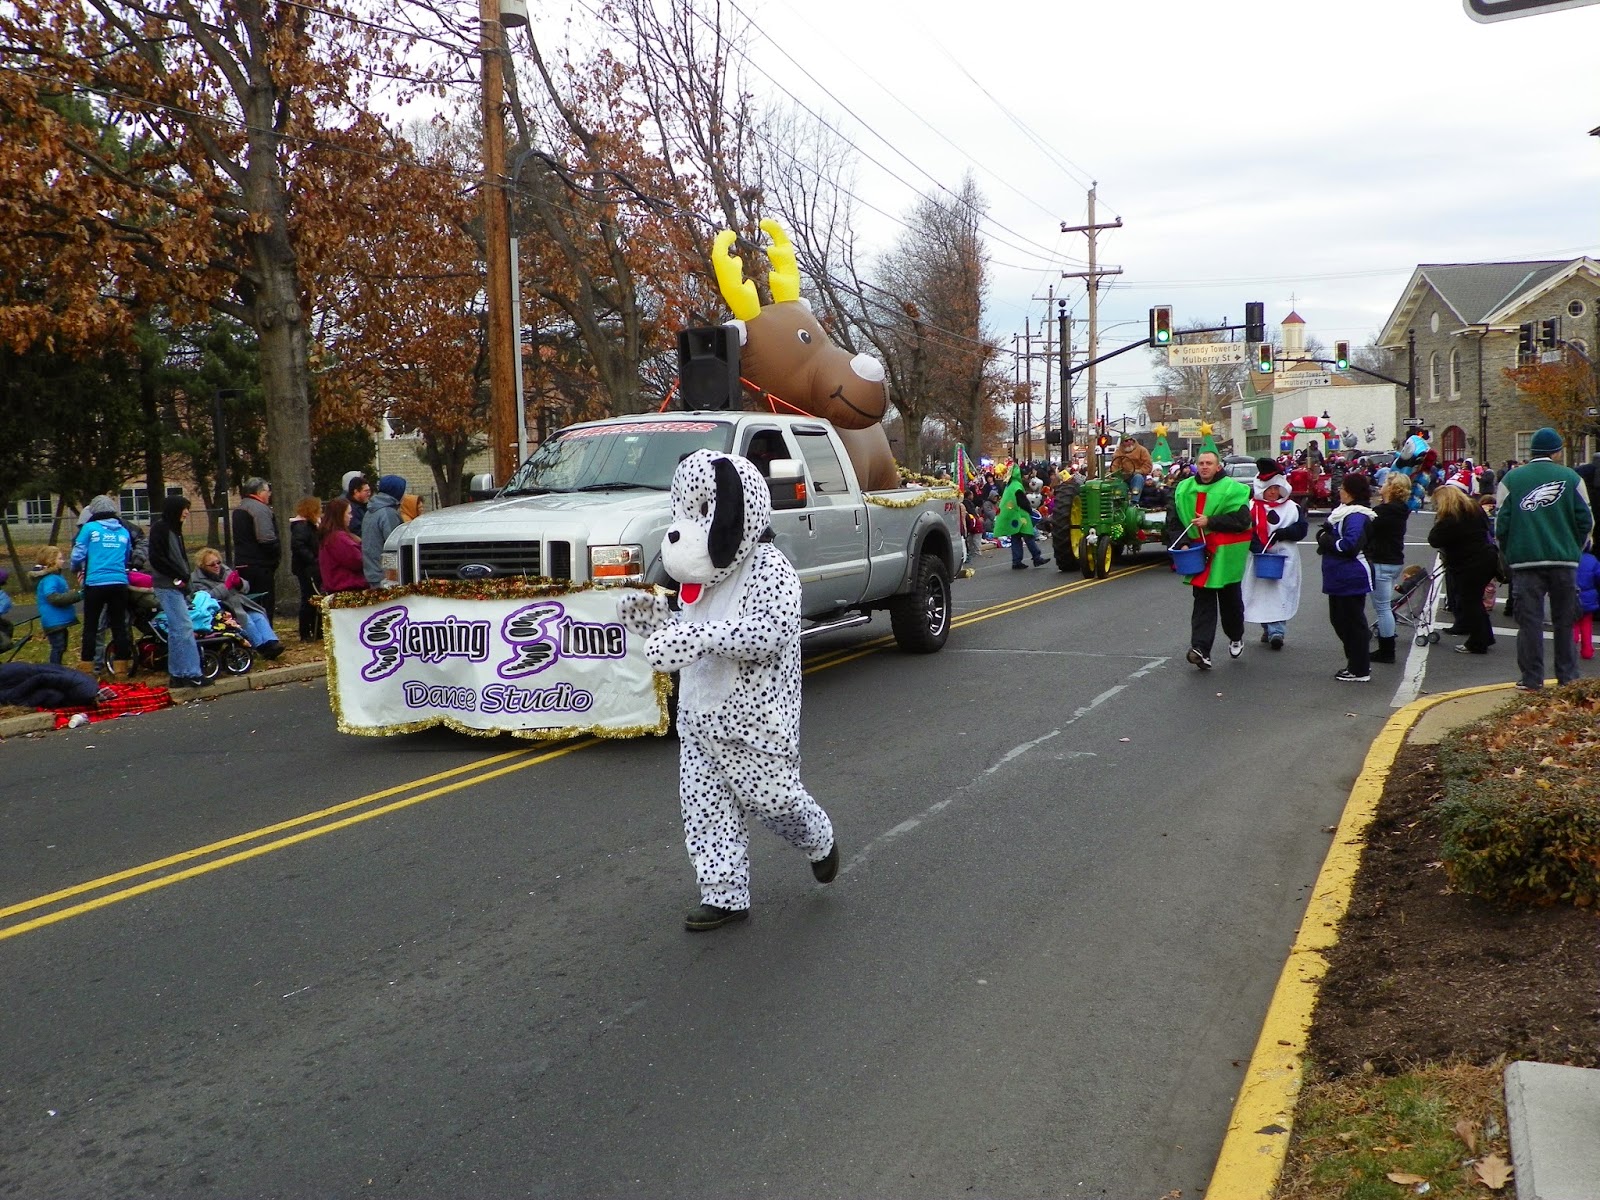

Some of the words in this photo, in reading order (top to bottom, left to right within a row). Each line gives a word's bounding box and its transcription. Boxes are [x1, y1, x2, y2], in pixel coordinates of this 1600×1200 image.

[1183, 347, 1209, 356] Grundy
[1211, 345, 1231, 353] Tower
[1233, 344, 1241, 352] Dr
[1182, 355, 1219, 364] Mulberry
[1222, 354, 1230, 362] St
[1284, 379, 1312, 387] Mulberry
[360, 604, 490, 682] Stepping
[497, 600, 626, 680] Stone
[403, 681, 477, 712] Dance
[480, 683, 593, 713] Studio
